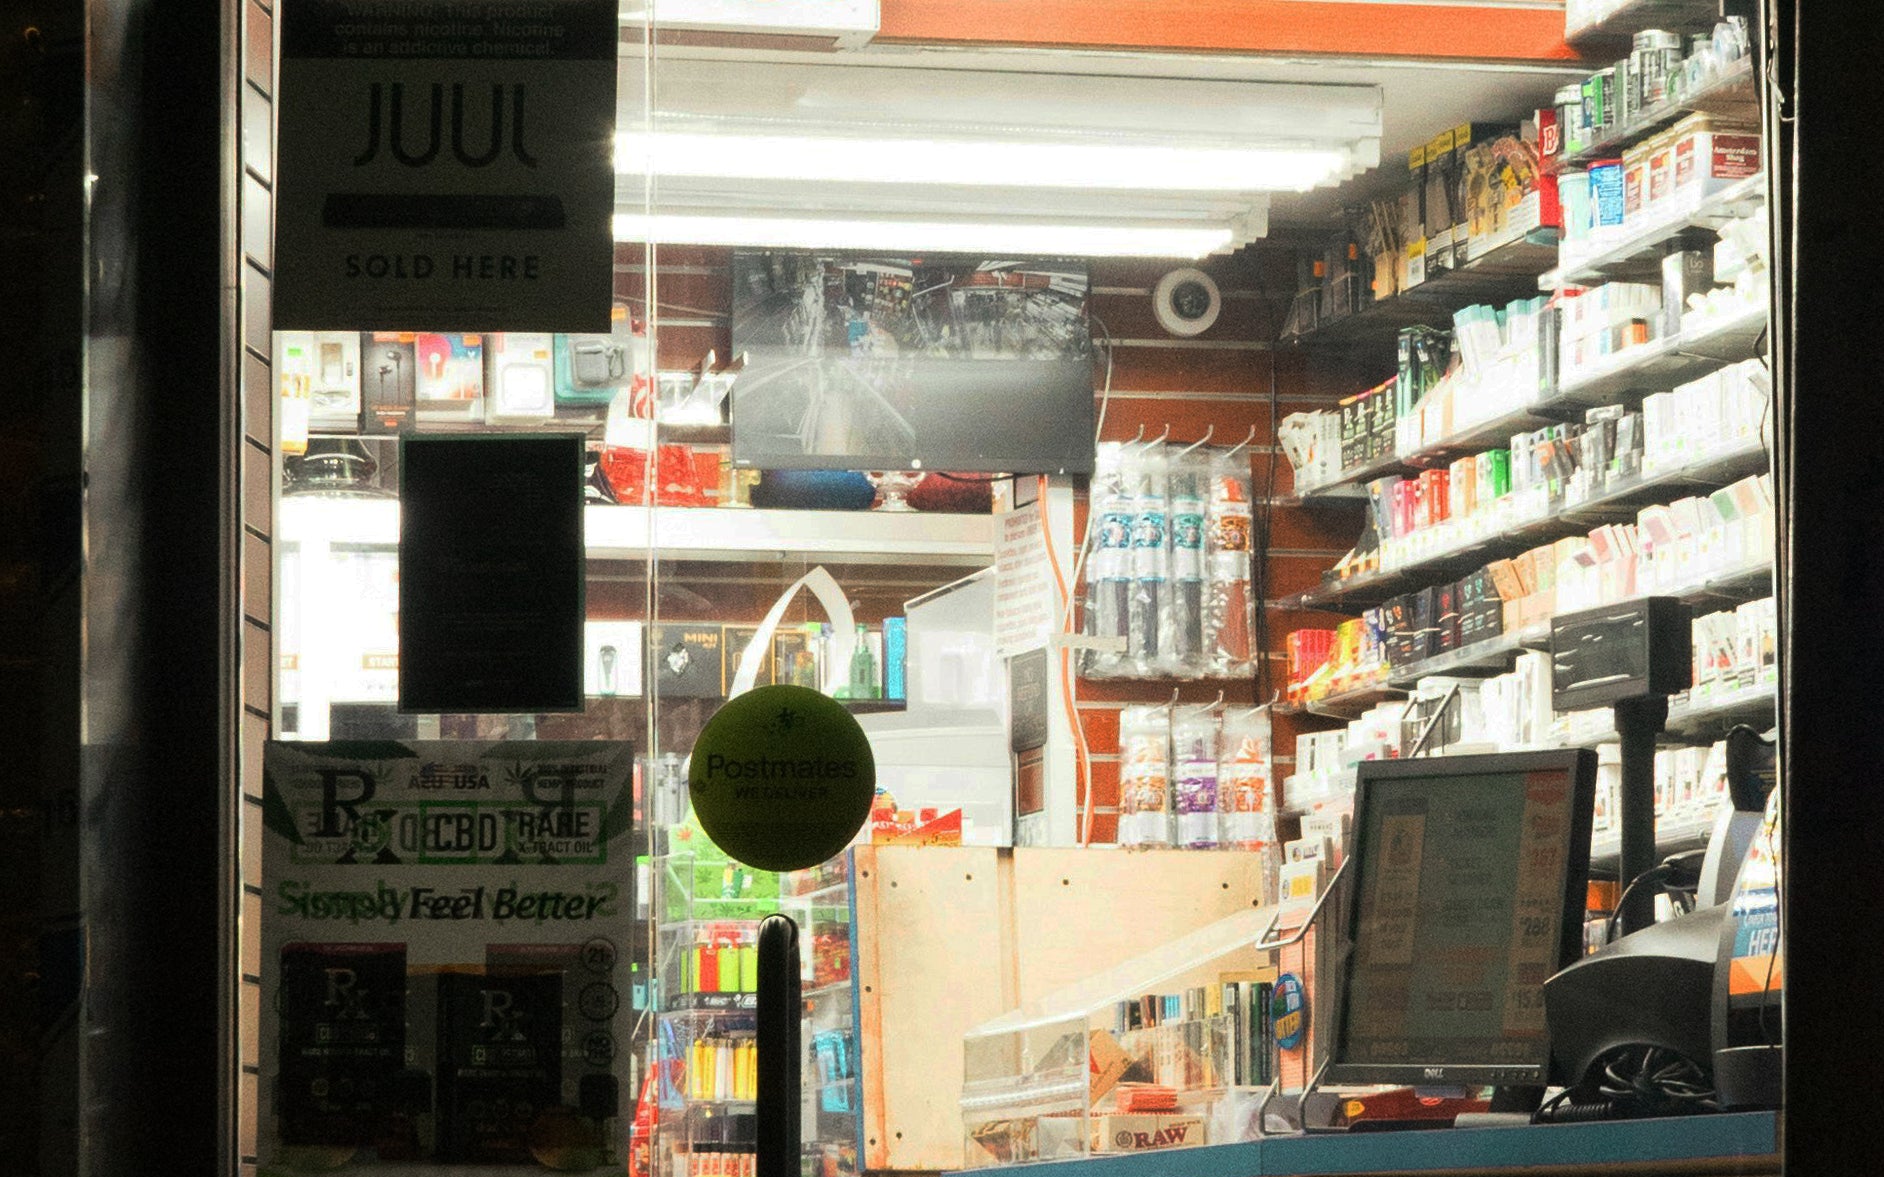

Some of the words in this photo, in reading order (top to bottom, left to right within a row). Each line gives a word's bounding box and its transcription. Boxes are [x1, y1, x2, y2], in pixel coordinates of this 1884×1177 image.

[335, 24, 408, 36] contains
[493, 23, 566, 37] Nicotine
[363, 44, 384, 54] an
[390, 41, 468, 55] addictive
[354, 82, 537, 168] JUUL
[345, 254, 434, 280] SOLD
[453, 255, 540, 280] HERE
[684, 632, 718, 644] MINI
[706, 753, 858, 780] Postmates
[452, 775, 490, 790] USA
[409, 886, 485, 920] Feel
[493, 886, 607, 920] Better
[1134, 1127, 1187, 1149] RAW
